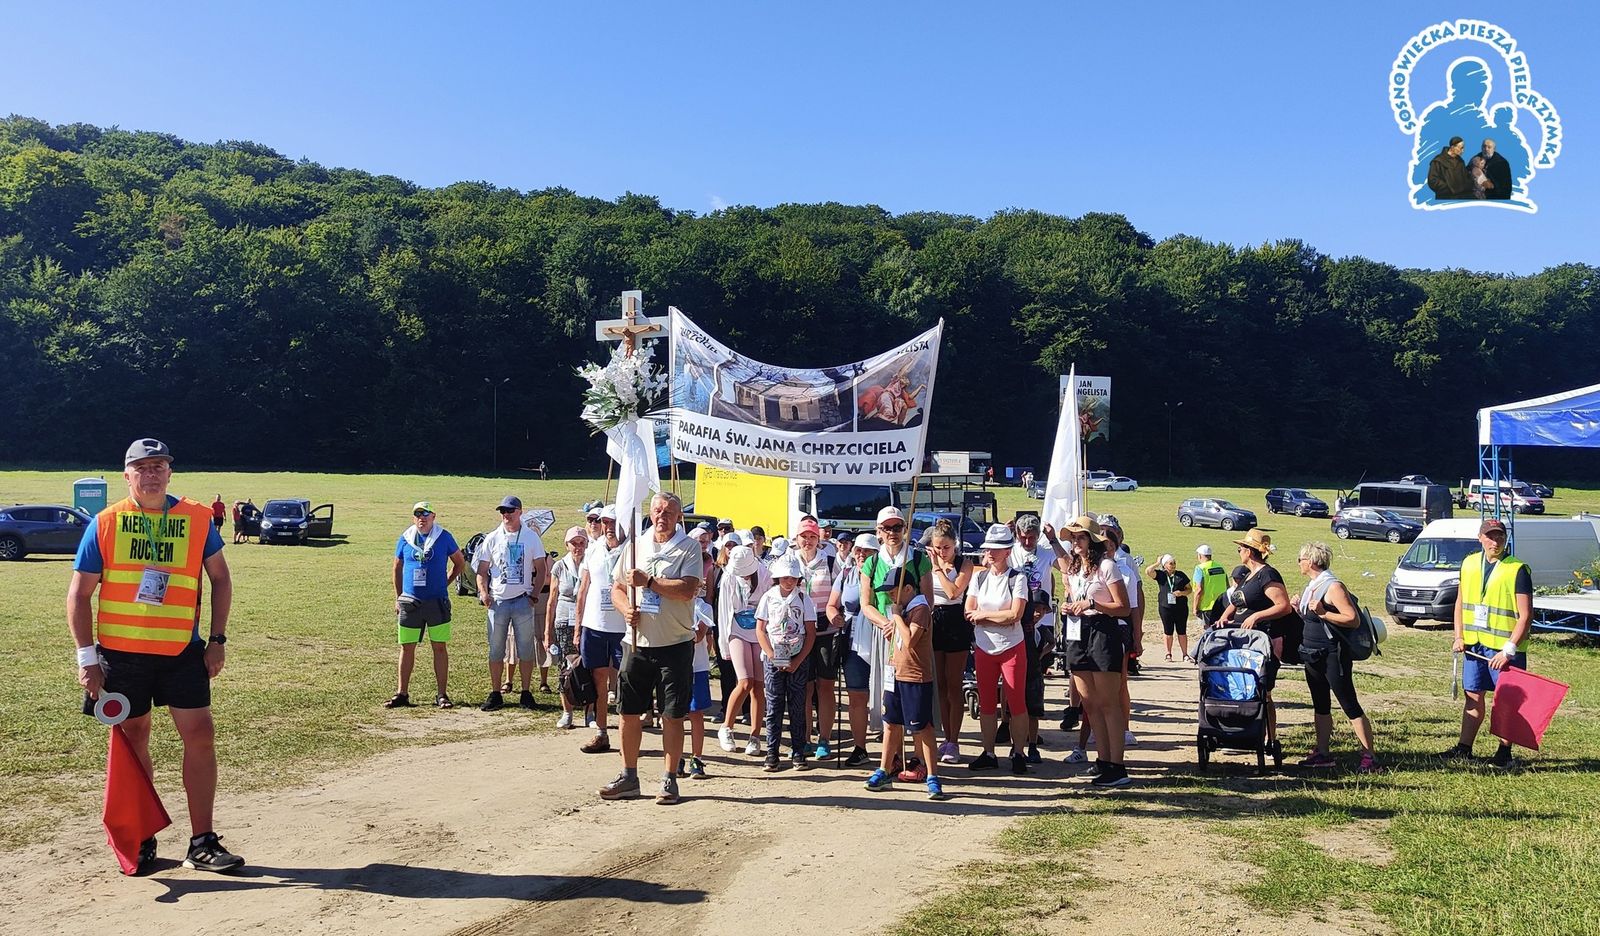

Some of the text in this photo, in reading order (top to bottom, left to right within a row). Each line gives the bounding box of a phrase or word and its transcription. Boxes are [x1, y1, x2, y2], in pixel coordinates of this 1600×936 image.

[1063, 387, 1108, 397] ENGELISTA
[1079, 380, 1092, 388] JAN
[679, 420, 907, 456] PARAFIA ŚW. JANA CHRZCICIELA
[676, 436, 693, 454] ŚW.
[695, 444, 730, 462] JANA
[733, 452, 841, 475] EWANGELISTY
[844, 462, 864, 475] W
[869, 457, 915, 475] PILICY
[122, 515, 186, 538] KIERANIE
